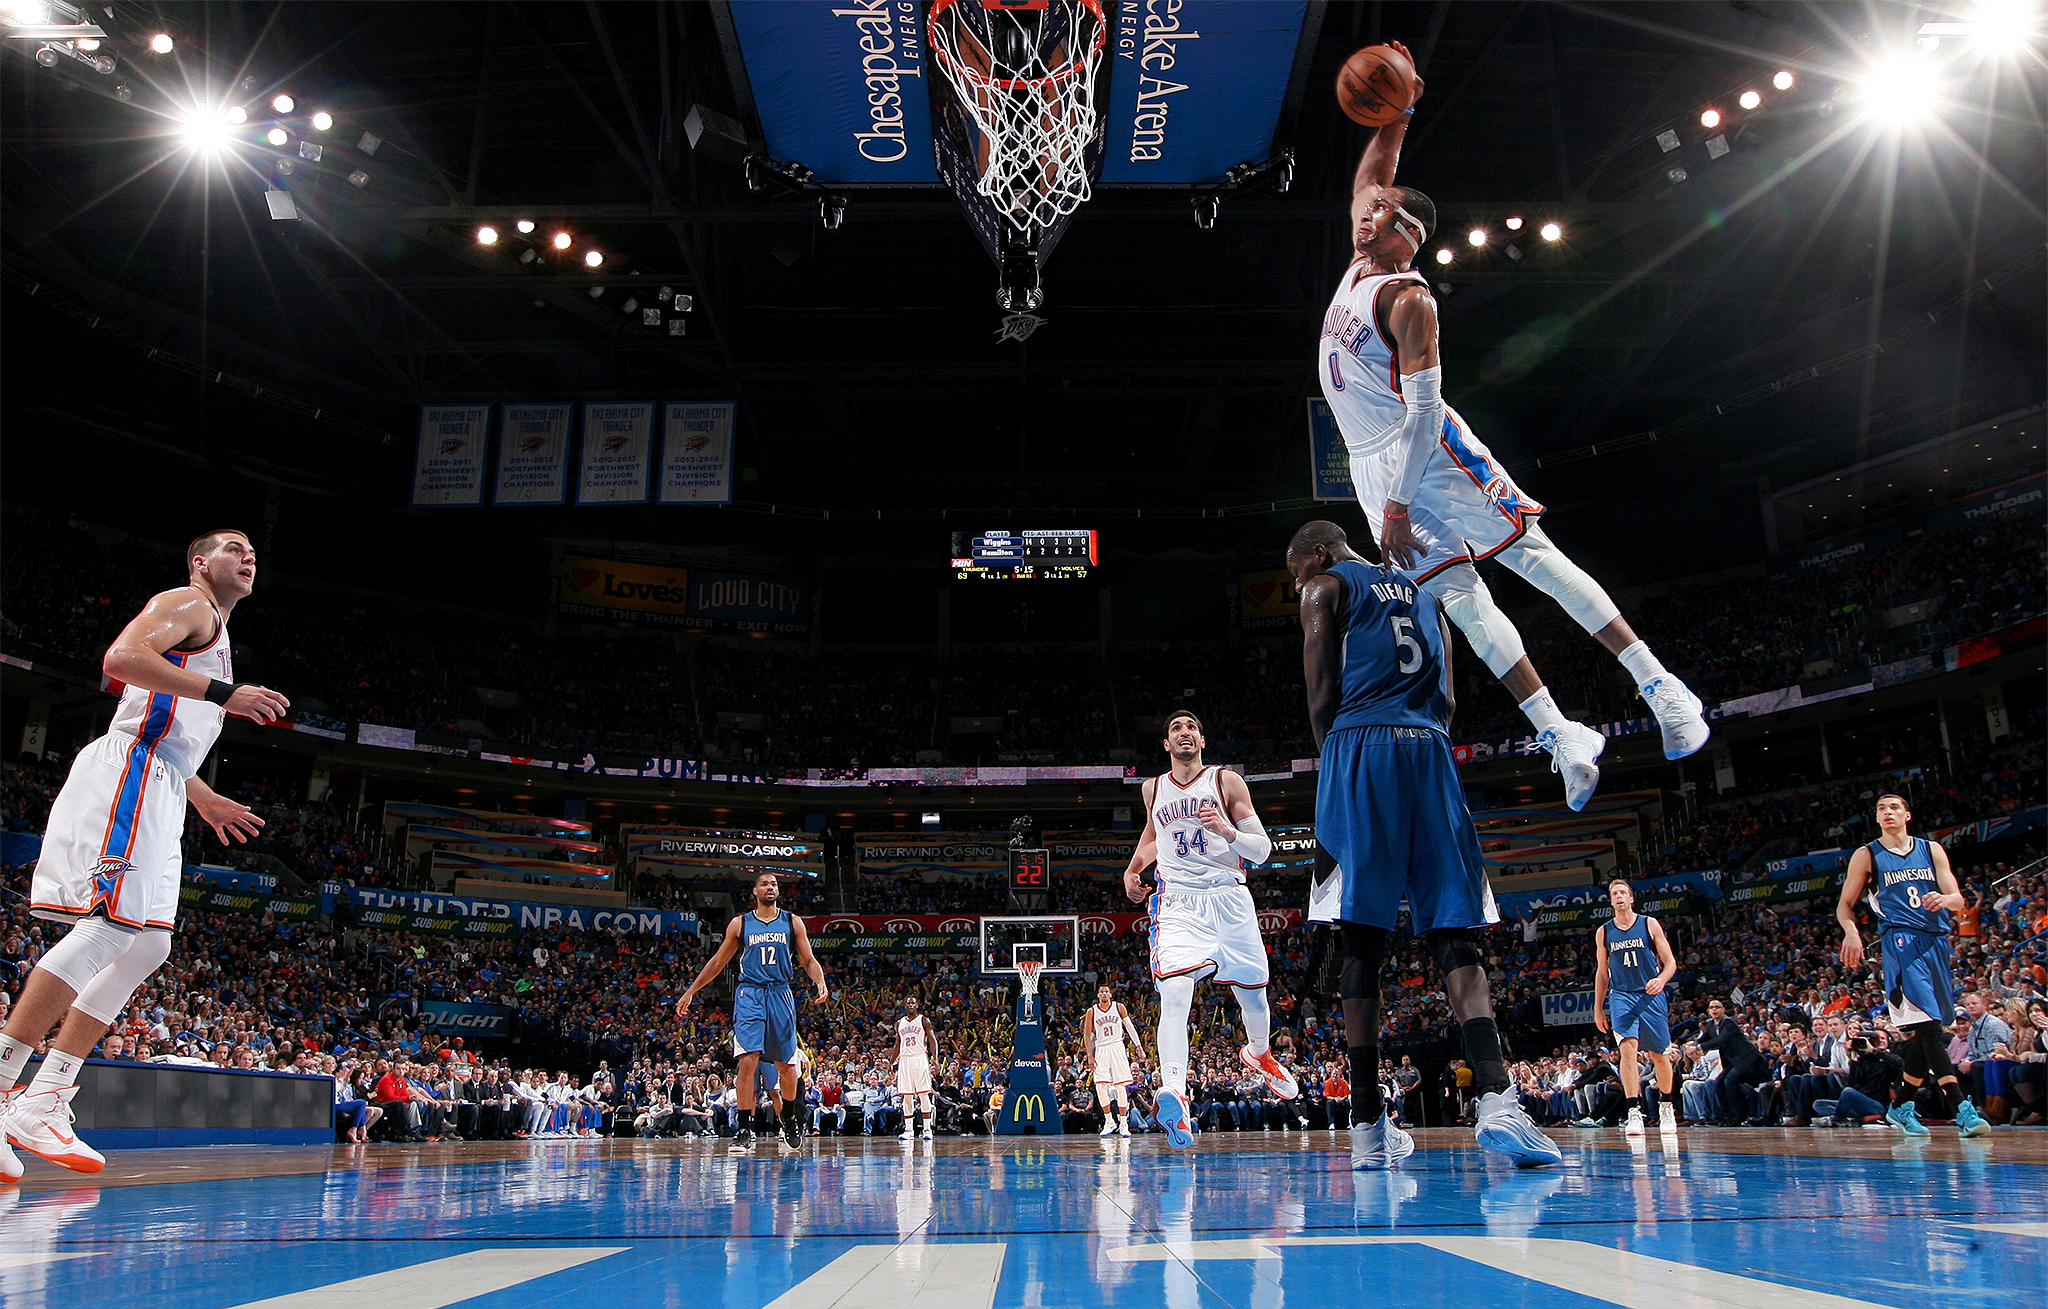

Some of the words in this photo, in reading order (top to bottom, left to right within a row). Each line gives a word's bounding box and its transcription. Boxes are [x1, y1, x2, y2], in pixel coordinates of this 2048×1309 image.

[1129, 73, 1190, 163] Arena
[1328, 349, 1346, 391] 0
[592, 408, 628, 420] OKLAHOMA
[630, 407, 646, 419] CITY
[672, 408, 710, 420] OKLAHOMA
[711, 408, 727, 419] CITY
[602, 420, 633, 432] THUNDER
[684, 420, 714, 432] THUNDER
[587, 464, 641, 472] NORTHWEST
[594, 472, 632, 480] DIVISION
[587, 480, 638, 488] CHAMPIONS
[1962, 490, 2043, 519] THUNDER
[983, 538, 1012, 547] Wiggins
[1025, 538, 1032, 546] 14
[1040, 538, 1045, 546] 0
[1054, 538, 1059, 546] 3
[1068, 538, 1072, 546] 0
[1081, 538, 1086, 546] 0
[1798, 542, 1866, 568] THUNDER
[952, 560, 973, 568] MIN
[1014, 566, 1034, 574] 5:15
[699, 579, 750, 610] LOUD
[757, 581, 800, 616] CITY
[1370, 582, 1414, 606] DIENG
[560, 604, 606, 618] BRING
[610, 610, 640, 622] THE
[644, 612, 714, 628] THUNDER
[736, 620, 772, 632] EXIT
[774, 622, 808, 634] NOW
[1242, 616, 1286, 630] BRING
[1388, 615, 1423, 675] 5
[1172, 826, 1208, 858] 34
[660, 840, 740, 854] RIVERWIND
[740, 844, 794, 858] CASINO
[864, 846, 941, 858] RIVERWIND
[943, 846, 995, 857] CASINO
[1056, 845, 1130, 855] RIVERWIND
[1766, 860, 1788, 872] 103
[258, 876, 278, 887] 118
[1016, 865, 1043, 885] 22
[1701, 870, 1721, 882] 102
[1883, 866, 1936, 887] MINNESOTA
[324, 883, 341, 894] 119
[1785, 876, 1831, 894] SUBWAY
[181, 887, 207, 900] WAY
[1730, 884, 1778, 902] SUBWAY
[1906, 886, 1922, 908] 8
[210, 893, 260, 910] SUBWAY
[265, 900, 317, 914] SUBWAY
[1640, 897, 1685, 914] SUBWAY
[361, 911, 408, 925] SUBWAY
[679, 912, 696, 922] 119
[1538, 909, 1584, 924] SUBWAY
[1590, 907, 1614, 919] SUB
[412, 917, 460, 930] SUBWAY
[464, 921, 514, 934] SUBWAY
[520, 906, 585, 932] NBA
[594, 912, 662, 936] COM
[1082, 921, 1110, 933] KIA
[748, 932, 787, 946] MINNESOTA
[810, 938, 847, 948] UBWAY
[852, 937, 900, 948] SUBWAY
[904, 936, 952, 948] SUBWAY
[957, 937, 978, 948] SUB
[1610, 937, 1645, 953] MINNESOTA
[760, 946, 776, 966] 12
[1623, 950, 1638, 968] 41
[436, 1010, 504, 1028] LIGHT
[1564, 1014, 1594, 1024] fresh
[1103, 1026, 1114, 1036] 21
[906, 1036, 916, 1046] 23
[1014, 1059, 1042, 1068] devon
